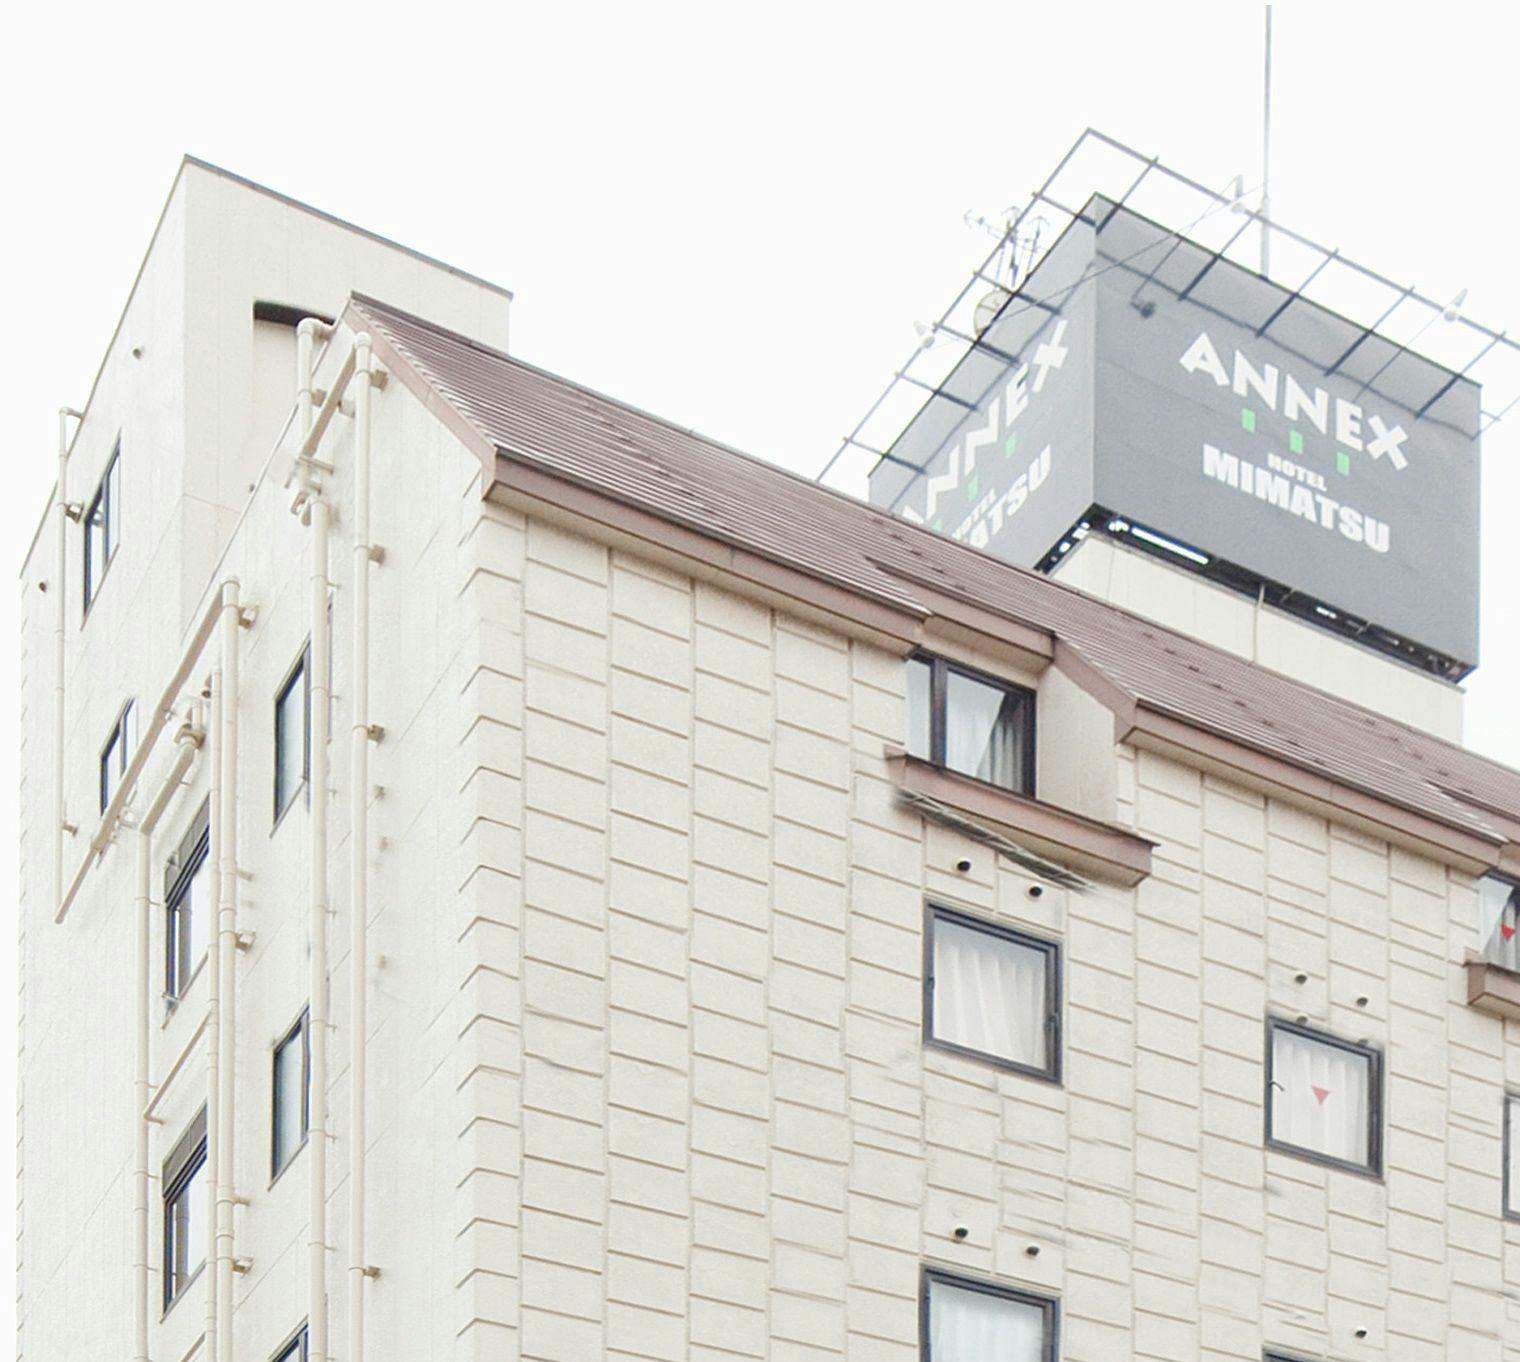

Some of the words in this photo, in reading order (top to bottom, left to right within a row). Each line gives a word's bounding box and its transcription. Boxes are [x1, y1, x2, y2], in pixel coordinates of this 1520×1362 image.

[1179, 332, 1408, 471] ANNEX
[1203, 443, 1390, 553] MIMATSU
[1268, 453, 1327, 492] HOTEL
